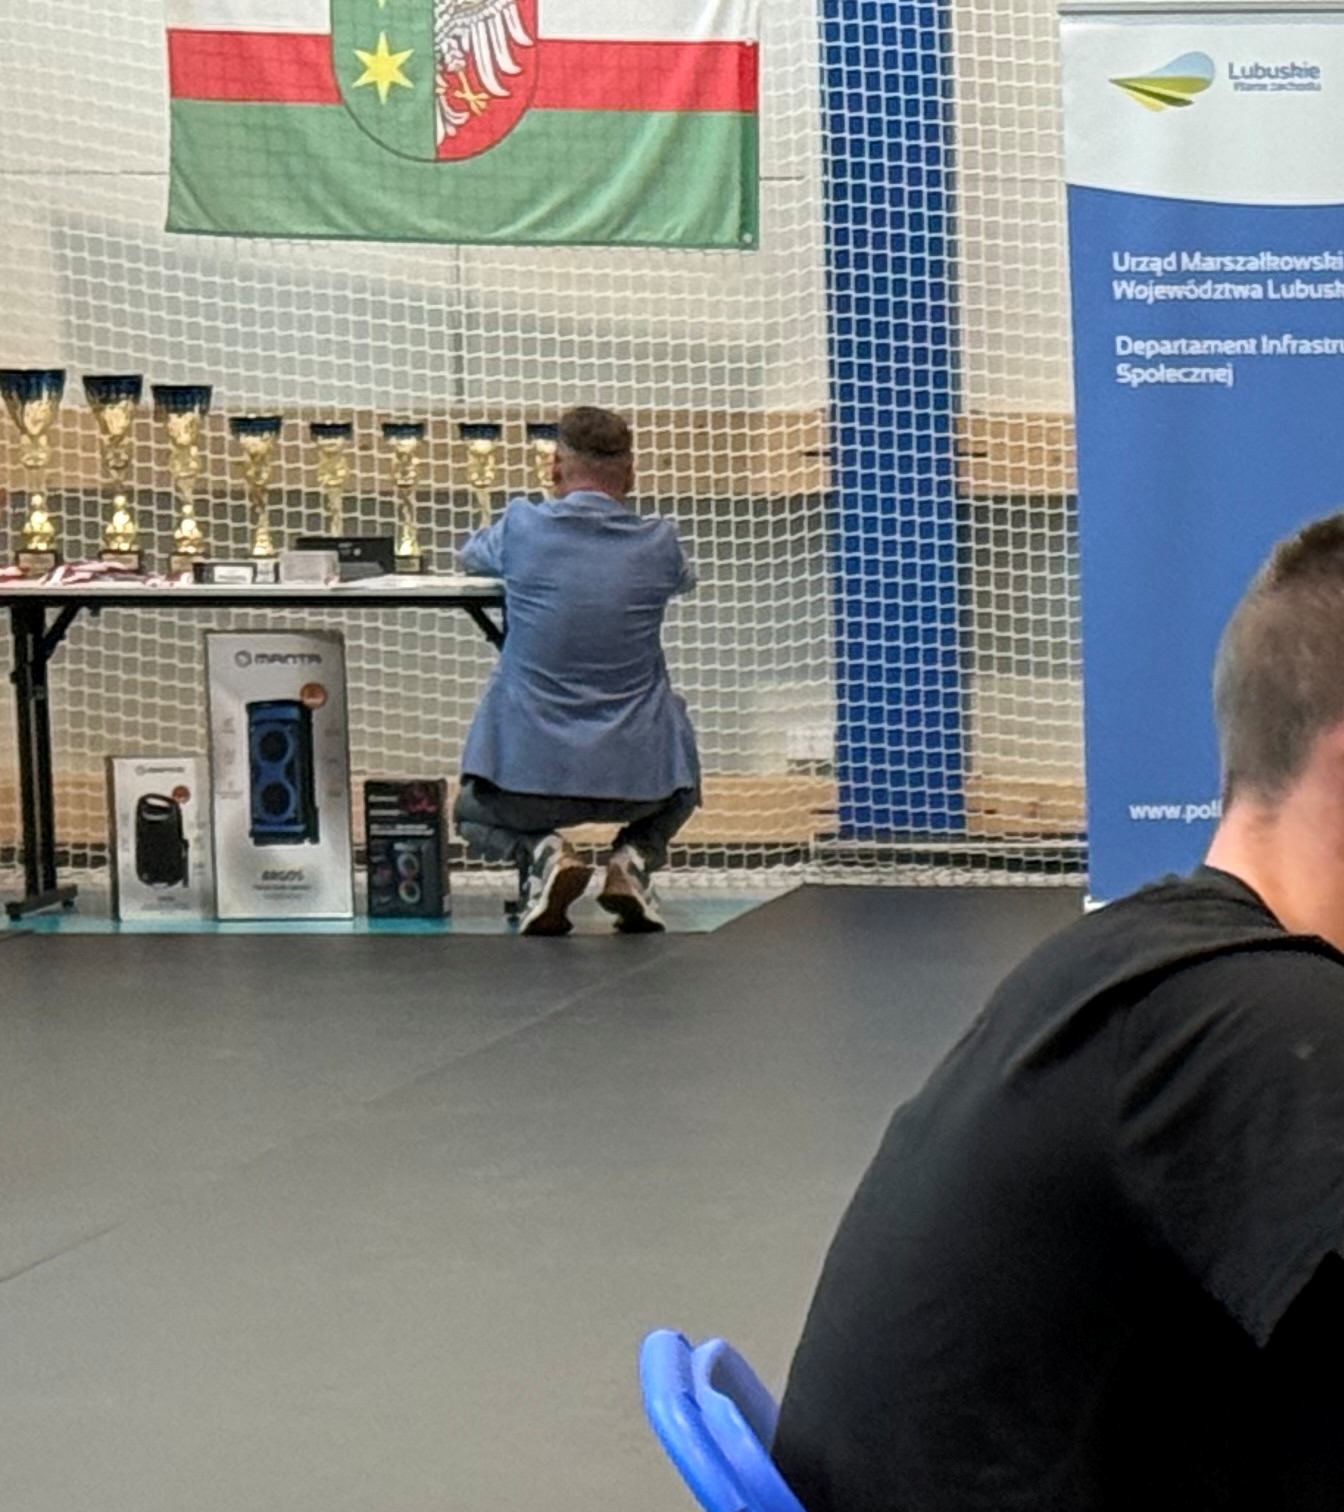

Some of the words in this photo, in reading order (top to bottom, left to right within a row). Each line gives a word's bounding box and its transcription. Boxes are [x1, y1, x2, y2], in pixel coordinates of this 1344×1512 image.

[1227, 61, 1321, 81] Lubuskie
[1112, 251, 1178, 277] Urząd
[1181, 250, 1344, 272] Marszałkowski
[1111, 278, 1264, 305] Województwa
[1115, 334, 1258, 360] Departament
[1115, 362, 1234, 388] Społecznej
